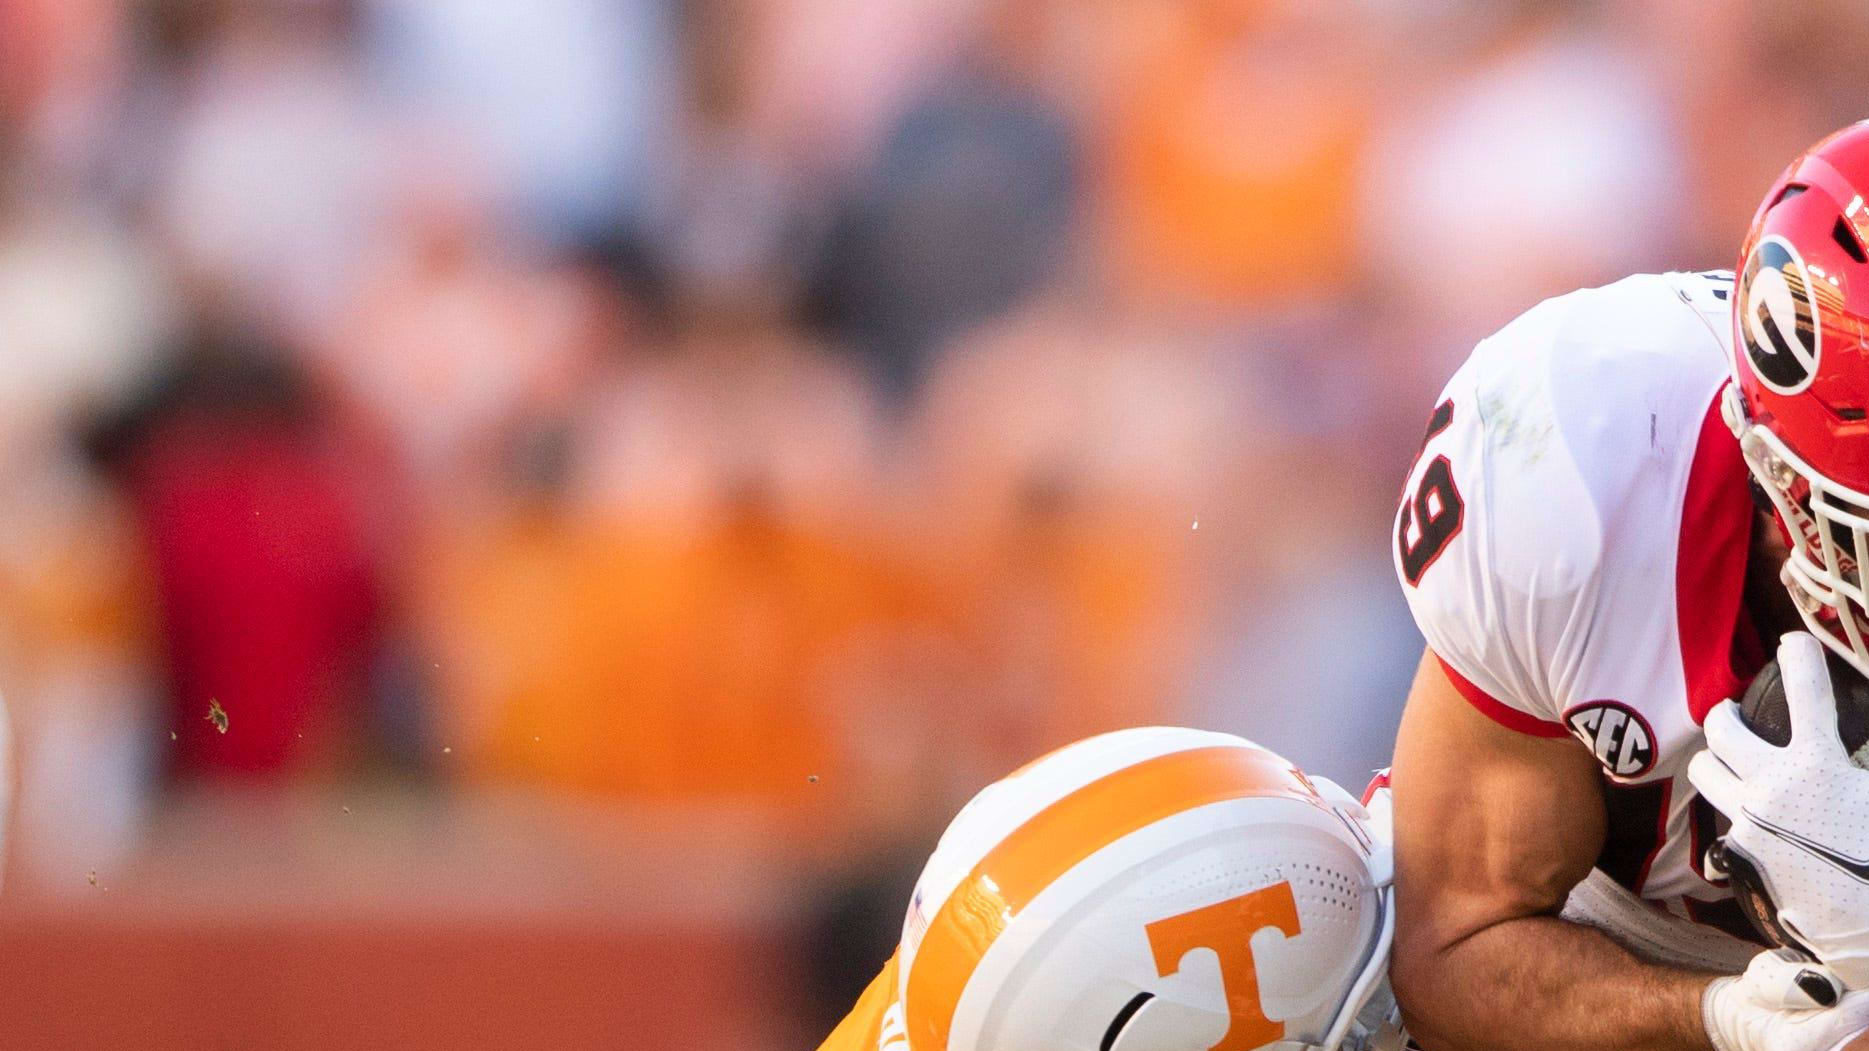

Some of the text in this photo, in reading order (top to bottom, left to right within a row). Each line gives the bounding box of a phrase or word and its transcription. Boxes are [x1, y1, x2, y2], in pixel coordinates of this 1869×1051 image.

[1748, 266, 1815, 378] G
[1398, 397, 1465, 590] 9
[1570, 707, 1649, 774] SEC
